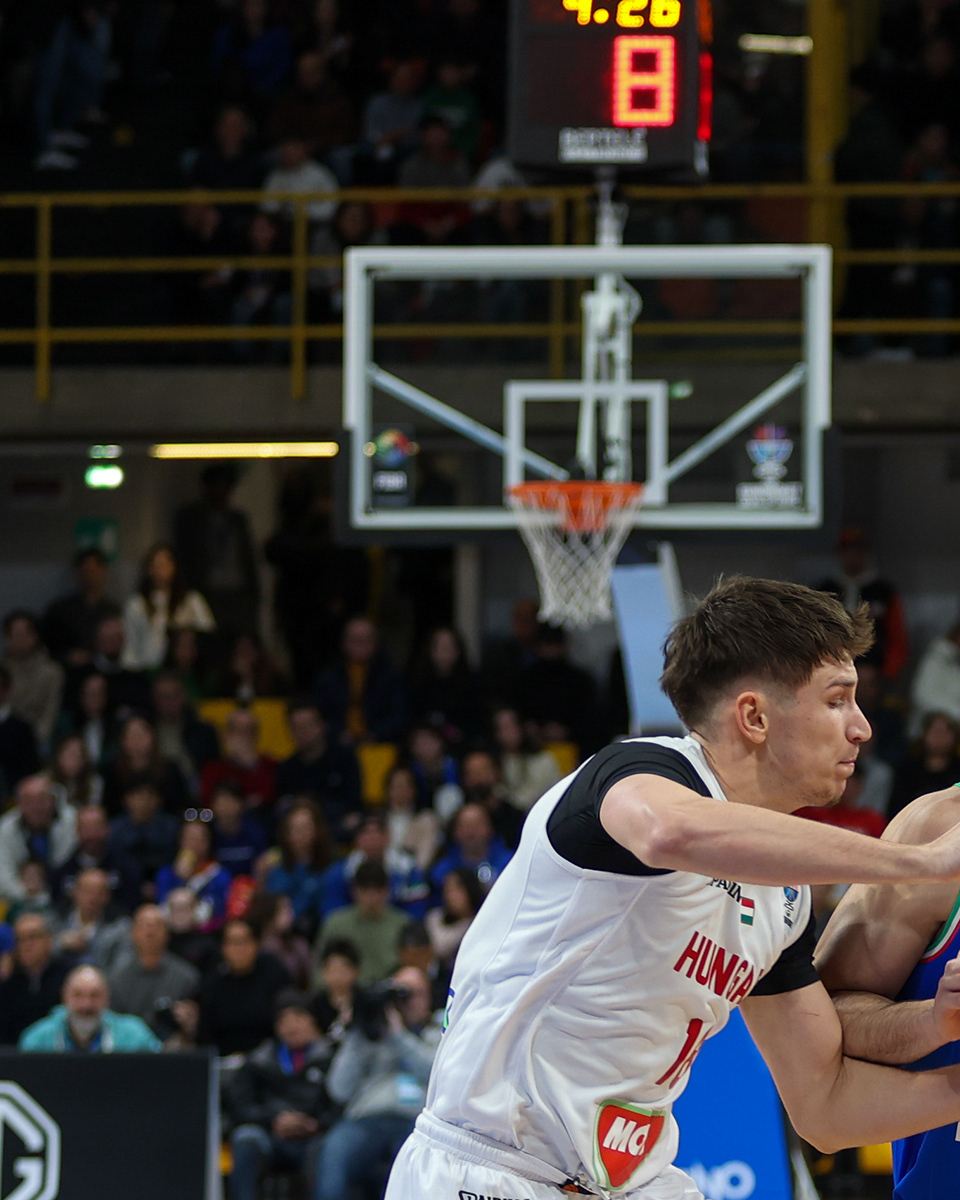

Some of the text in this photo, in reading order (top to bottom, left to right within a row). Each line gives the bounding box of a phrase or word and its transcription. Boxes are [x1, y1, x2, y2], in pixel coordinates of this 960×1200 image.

[613, 34, 676, 127] 8
[673, 931, 764, 1005] HUNGA
[602, 1116, 651, 1157] MO
